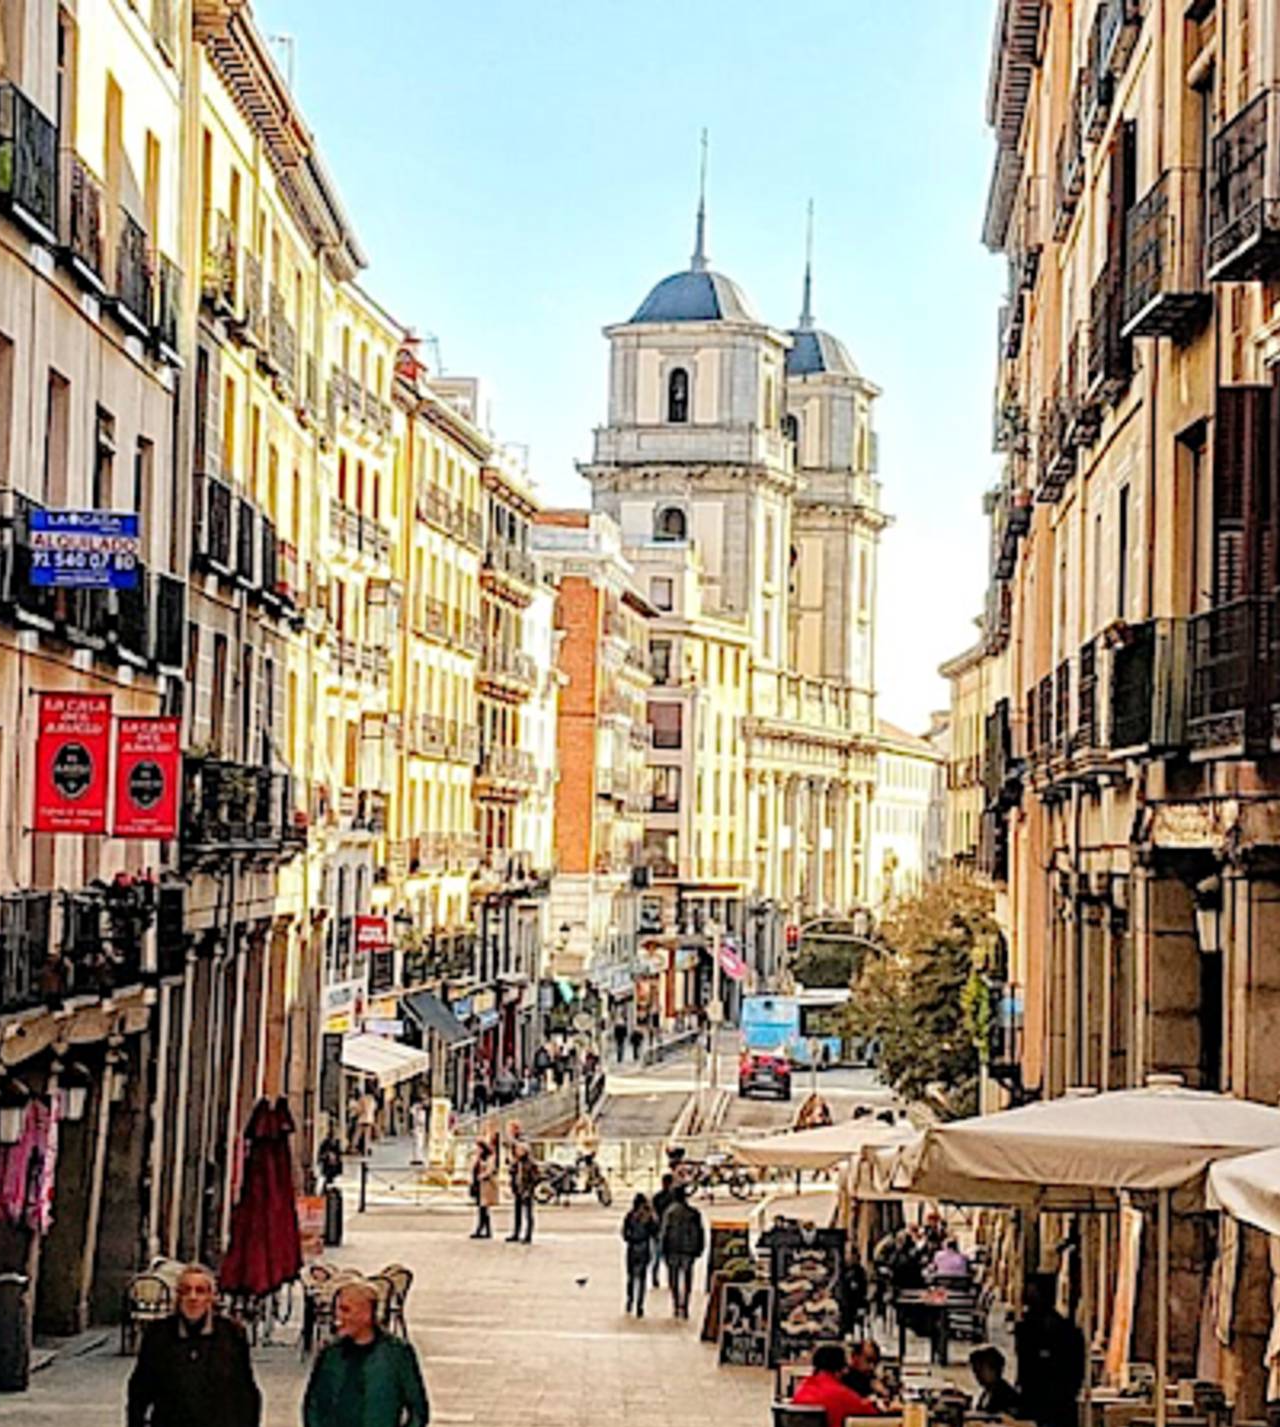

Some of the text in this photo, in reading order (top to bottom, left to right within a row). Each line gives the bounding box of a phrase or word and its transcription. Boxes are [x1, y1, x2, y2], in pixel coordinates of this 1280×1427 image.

[47, 514, 67, 526] LA
[33, 533, 139, 553] ALQUILADO
[44, 698, 65, 712] LA
